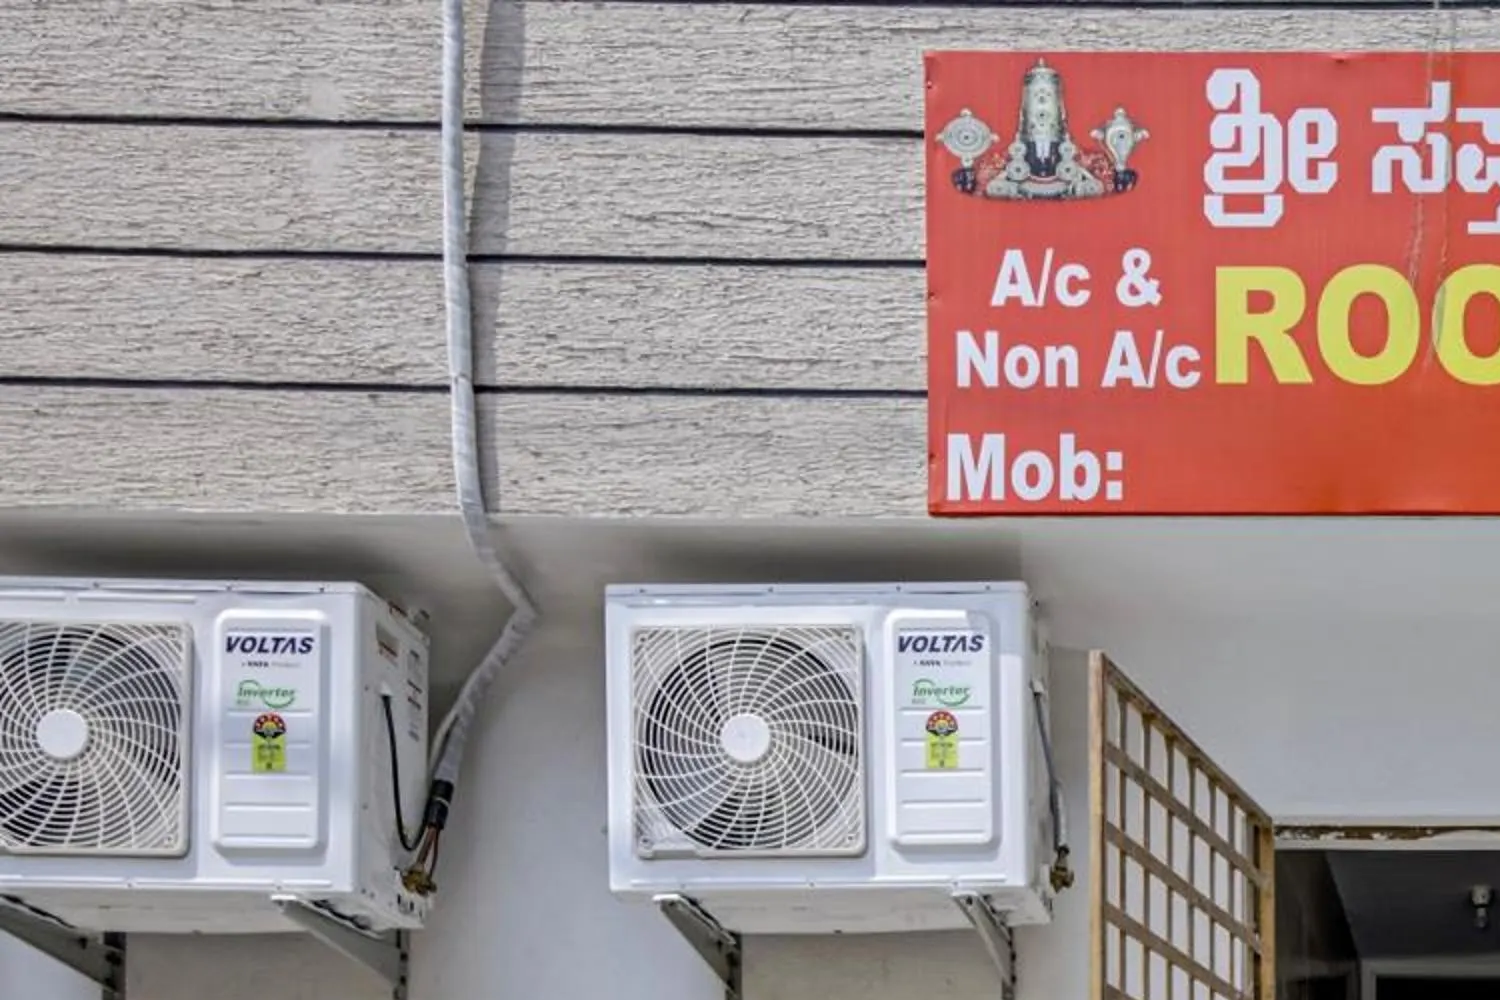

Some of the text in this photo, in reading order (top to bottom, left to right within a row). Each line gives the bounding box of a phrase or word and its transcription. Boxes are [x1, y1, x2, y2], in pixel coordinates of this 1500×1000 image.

[1204, 69, 1338, 227] ಶ್ರೀ
[991, 248, 1161, 307] A/c &
[956, 331, 1202, 389] Non A/c
[946, 432, 1125, 501] Mob:
[225, 636, 314, 654] VOLTAS
[898, 635, 984, 653] VOLTAS
